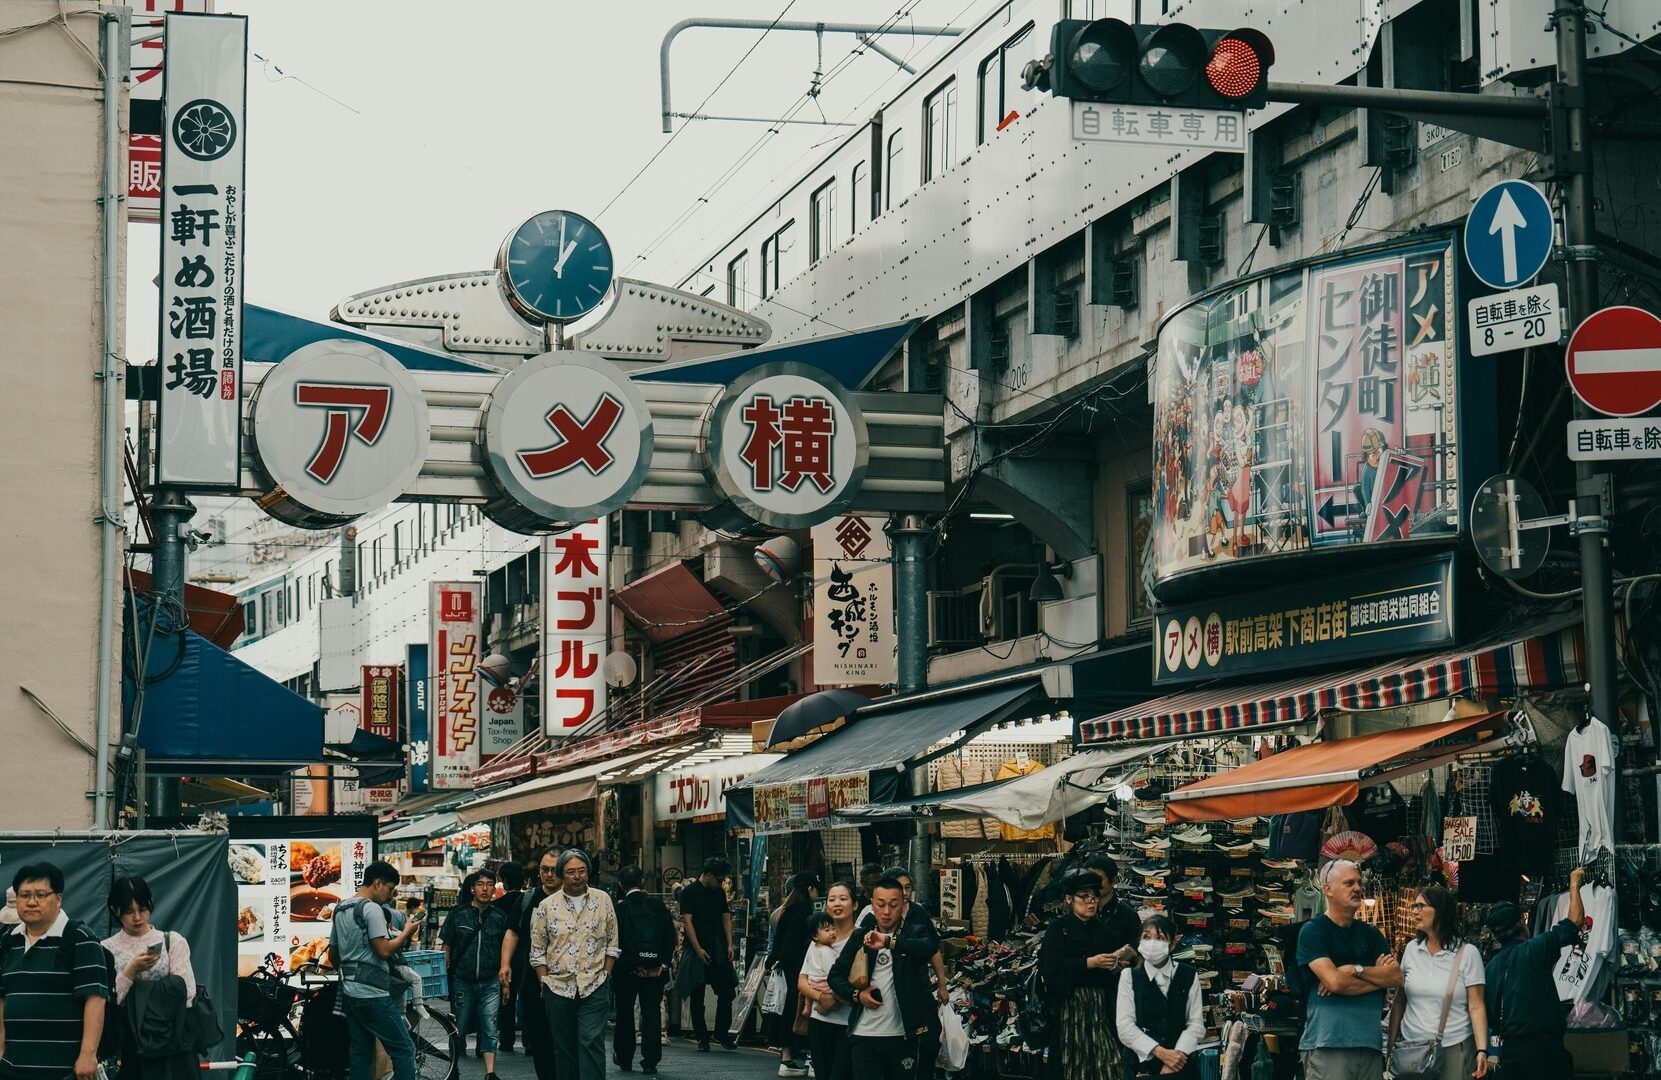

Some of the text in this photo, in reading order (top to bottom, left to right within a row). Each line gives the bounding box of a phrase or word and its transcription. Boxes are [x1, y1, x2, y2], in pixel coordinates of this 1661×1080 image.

[1082, 106, 1238, 143] 自転車専用
[166, 184, 220, 399] 一軒め酒場
[222, 185, 237, 368] おやじが喜ぶこだわりの酒と肴だけの店
[1476, 295, 1551, 325] 自転車を除く
[1357, 271, 1399, 424] 御徒町
[1408, 261, 1441, 401] アメ横
[1012, 364, 1027, 392] 206
[1319, 280, 1355, 482] センター
[296, 382, 837, 497] アメ横
[1168, 622, 1221, 661] アメ横
[1225, 600, 1348, 656] 駅前高架下商店街
[417, 680, 425, 711] OUTLET
[449, 635, 476, 751] JJTストア
[487, 727, 518, 735] Tax-free
[488, 717, 517, 726] Japan.
[492, 736, 513, 745] Shop
[1453, 827, 1475, 838] SALE
[278, 844, 288, 870] ちくわ
[354, 841, 364, 860] 名物
